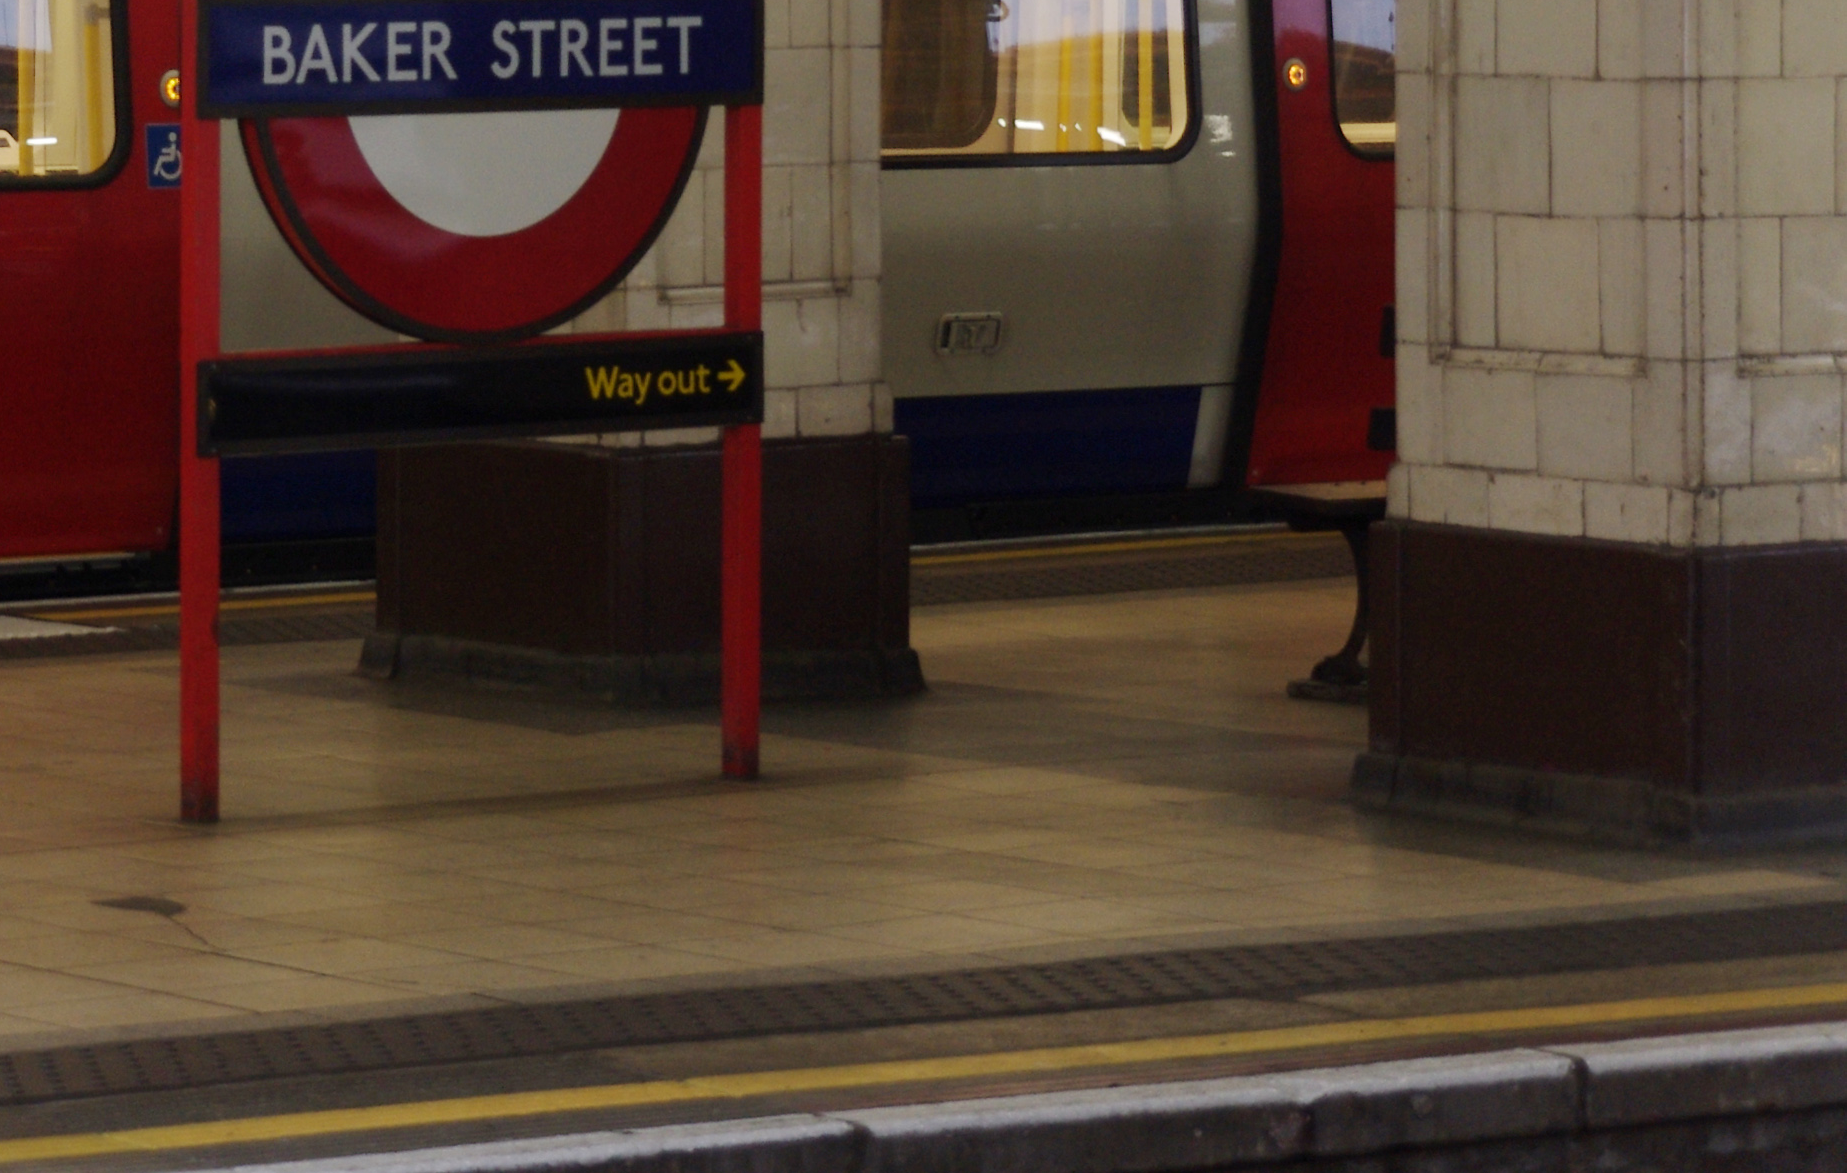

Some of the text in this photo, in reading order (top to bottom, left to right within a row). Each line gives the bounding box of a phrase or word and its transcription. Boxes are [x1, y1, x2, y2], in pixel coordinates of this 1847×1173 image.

[261, 16, 703, 85] BAKER STREET
[584, 364, 711, 405] Way out
